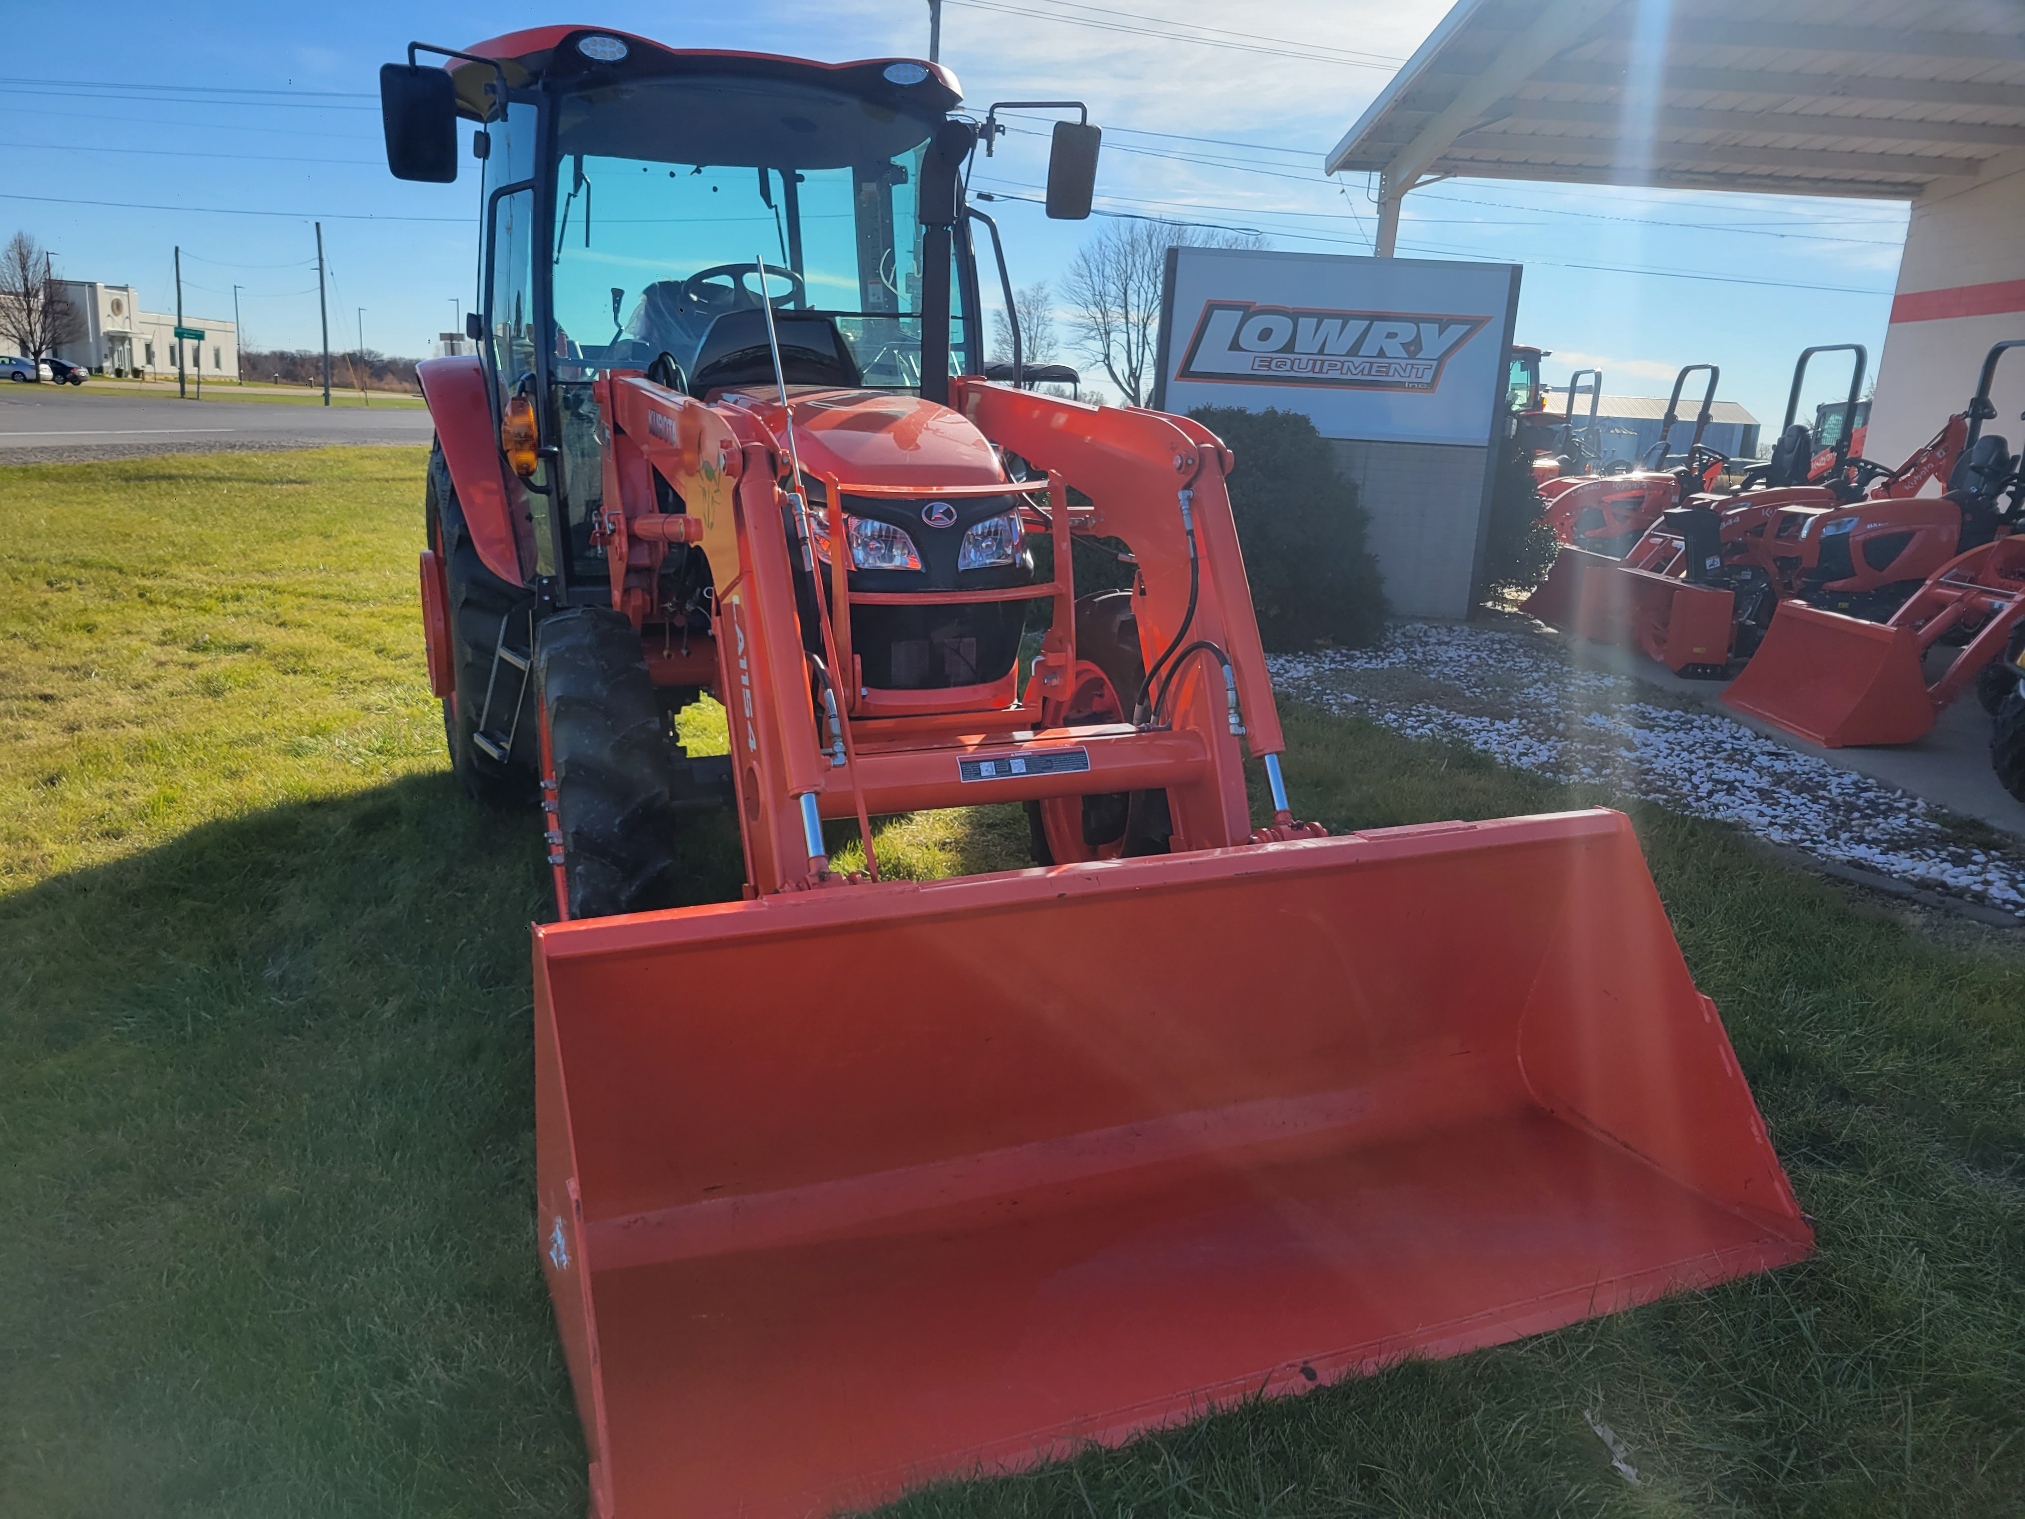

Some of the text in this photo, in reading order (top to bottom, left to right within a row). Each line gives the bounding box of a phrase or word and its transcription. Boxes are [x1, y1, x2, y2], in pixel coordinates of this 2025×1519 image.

[1190, 309, 1472, 374] LOWRY
[1252, 356, 1435, 379] EQUIPMENT
[1405, 381, 1430, 389] Inc.
[648, 408, 679, 448] KUBOTA
[1612, 481, 1648, 491] Kubota
[1904, 462, 1935, 491] Kubota
[732, 594, 758, 753] LA1154
